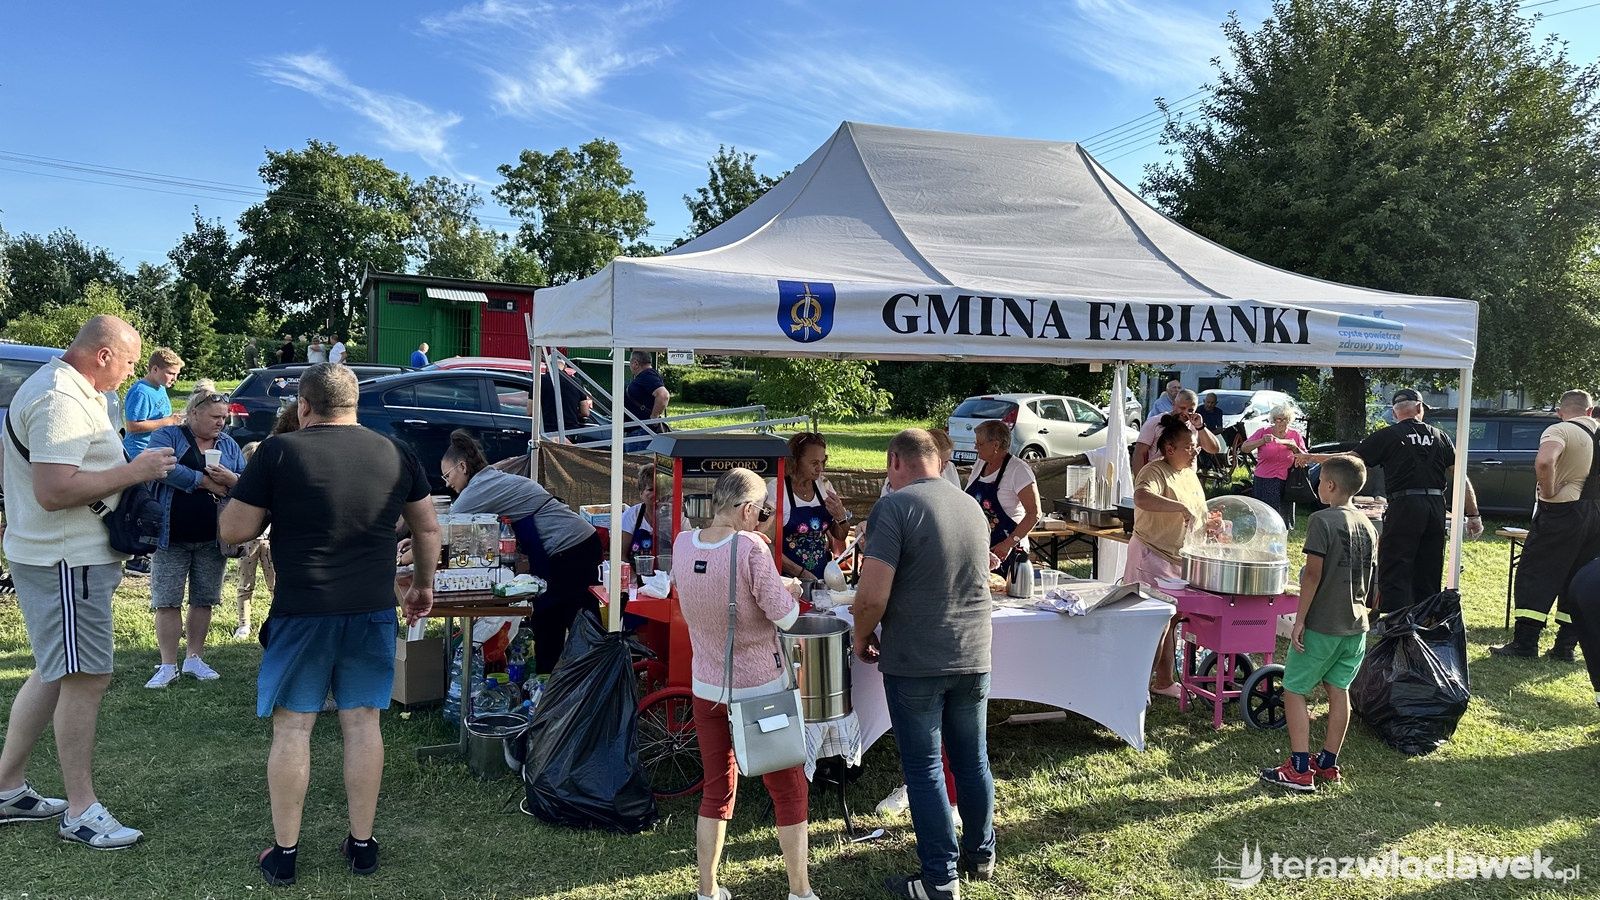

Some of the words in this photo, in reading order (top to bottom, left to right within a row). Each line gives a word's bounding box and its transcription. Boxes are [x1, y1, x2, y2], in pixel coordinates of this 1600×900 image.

[882, 293, 1071, 339] GMINA
[1085, 301, 1312, 345] FABIANKI
[1338, 340, 1373, 352] zdrowy
[710, 460, 758, 470] POPCORN
